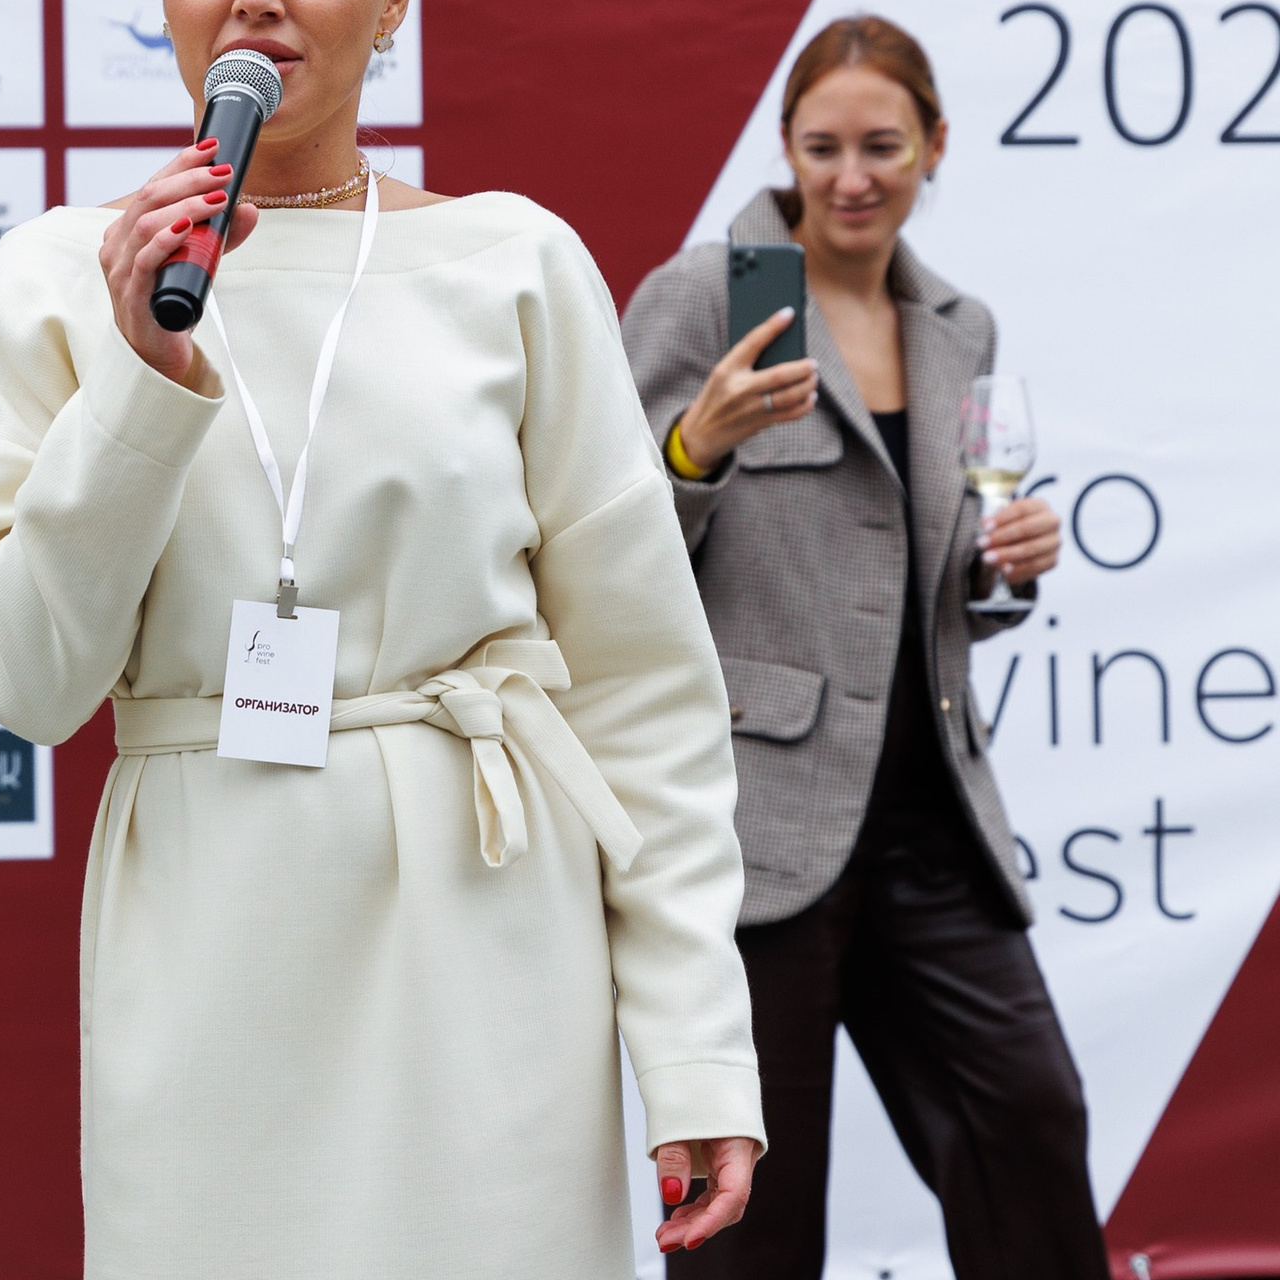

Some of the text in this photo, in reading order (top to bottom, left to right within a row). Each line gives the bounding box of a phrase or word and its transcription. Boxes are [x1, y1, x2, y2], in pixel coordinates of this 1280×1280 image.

[257, 643, 271, 651] pro
[255, 657, 270, 665] fest
[988, 616, 1277, 746] ine
[235, 697, 319, 716] ОРГАНИЗАТОР
